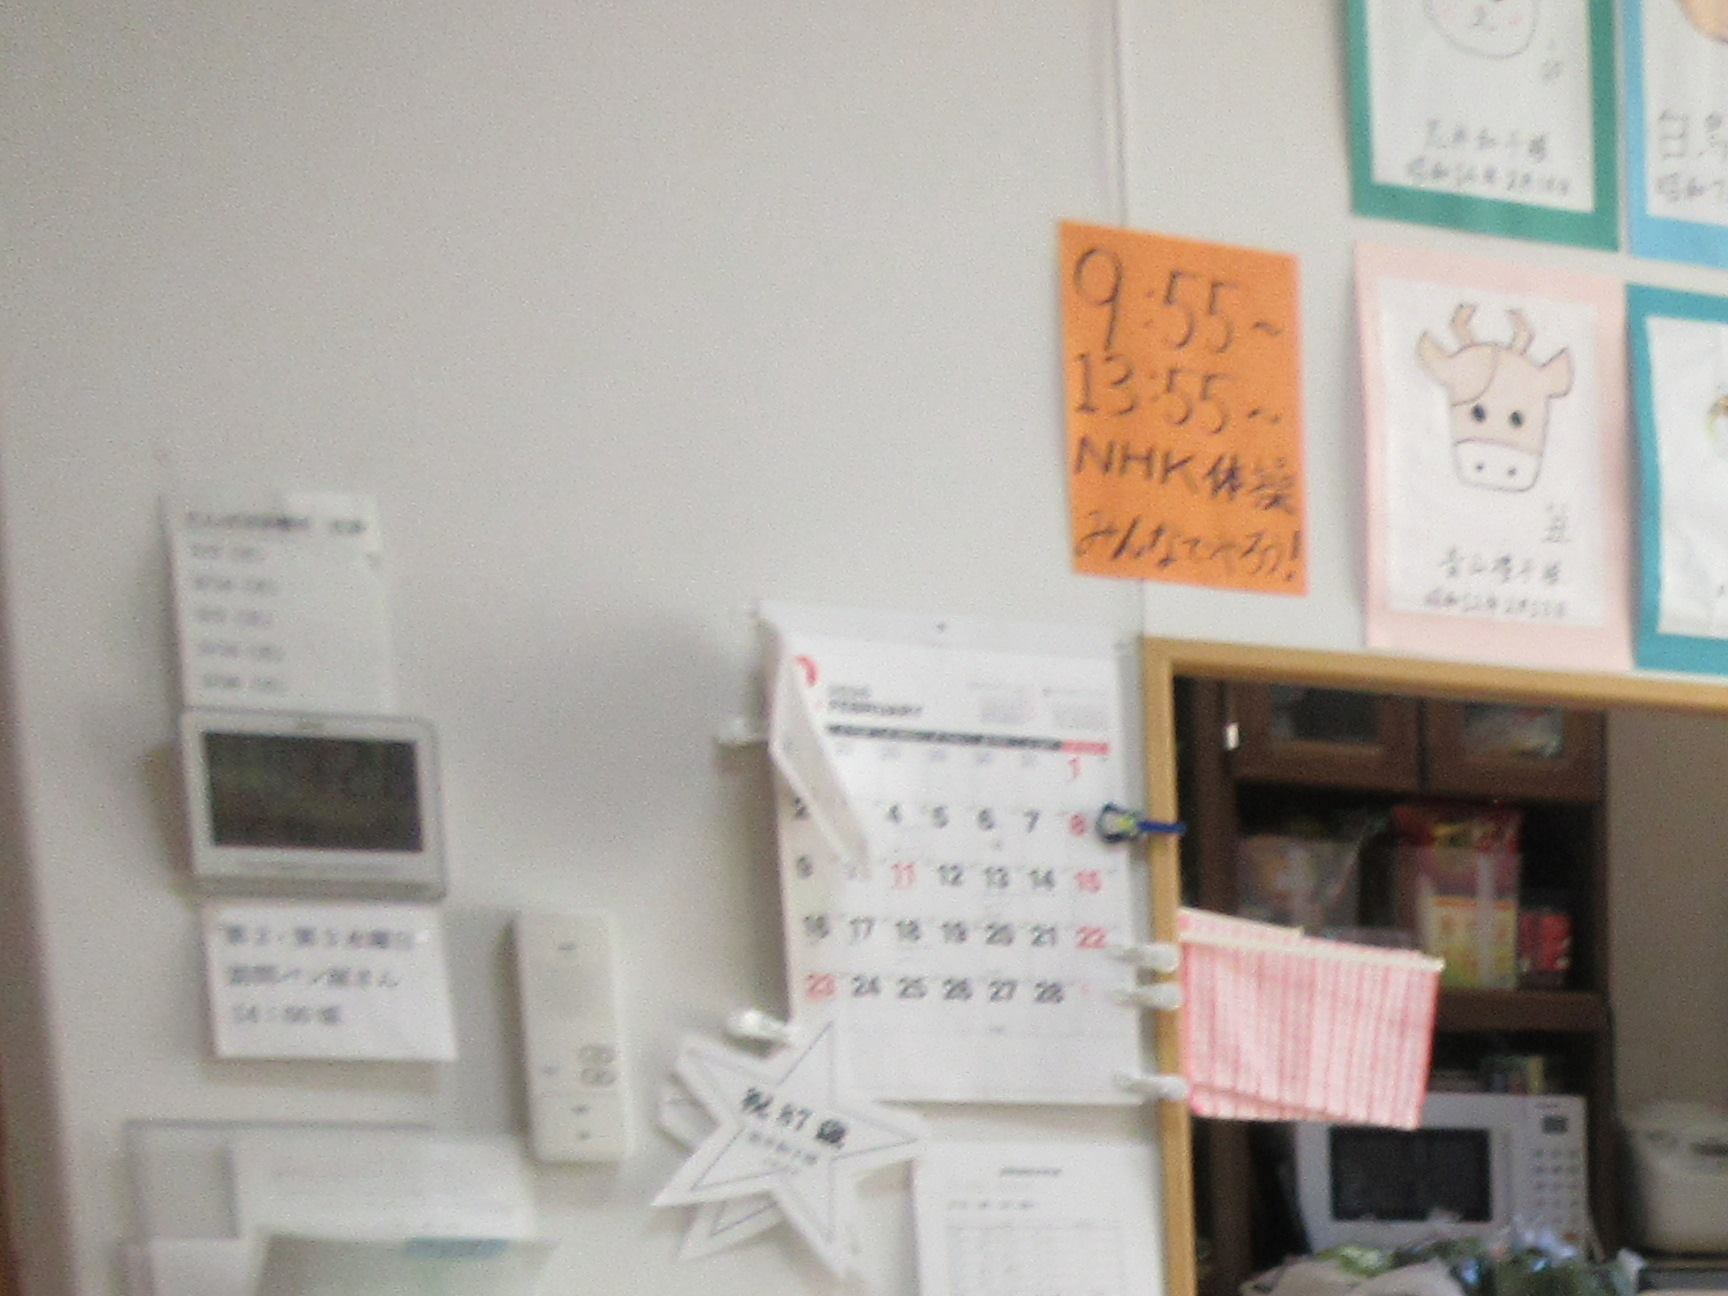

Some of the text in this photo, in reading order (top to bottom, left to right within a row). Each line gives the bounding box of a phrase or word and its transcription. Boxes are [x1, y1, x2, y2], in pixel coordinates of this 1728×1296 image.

[1023, 809, 1040, 834] 7
[890, 861, 916, 889] 11
[937, 863, 964, 888] 12
[983, 865, 1010, 889] 13
[1028, 867, 1055, 890] 14
[803, 913, 1107, 950] 16 17 18 19 20 21 22
[805, 971, 1065, 1005] 23 24 25 26 27 28
